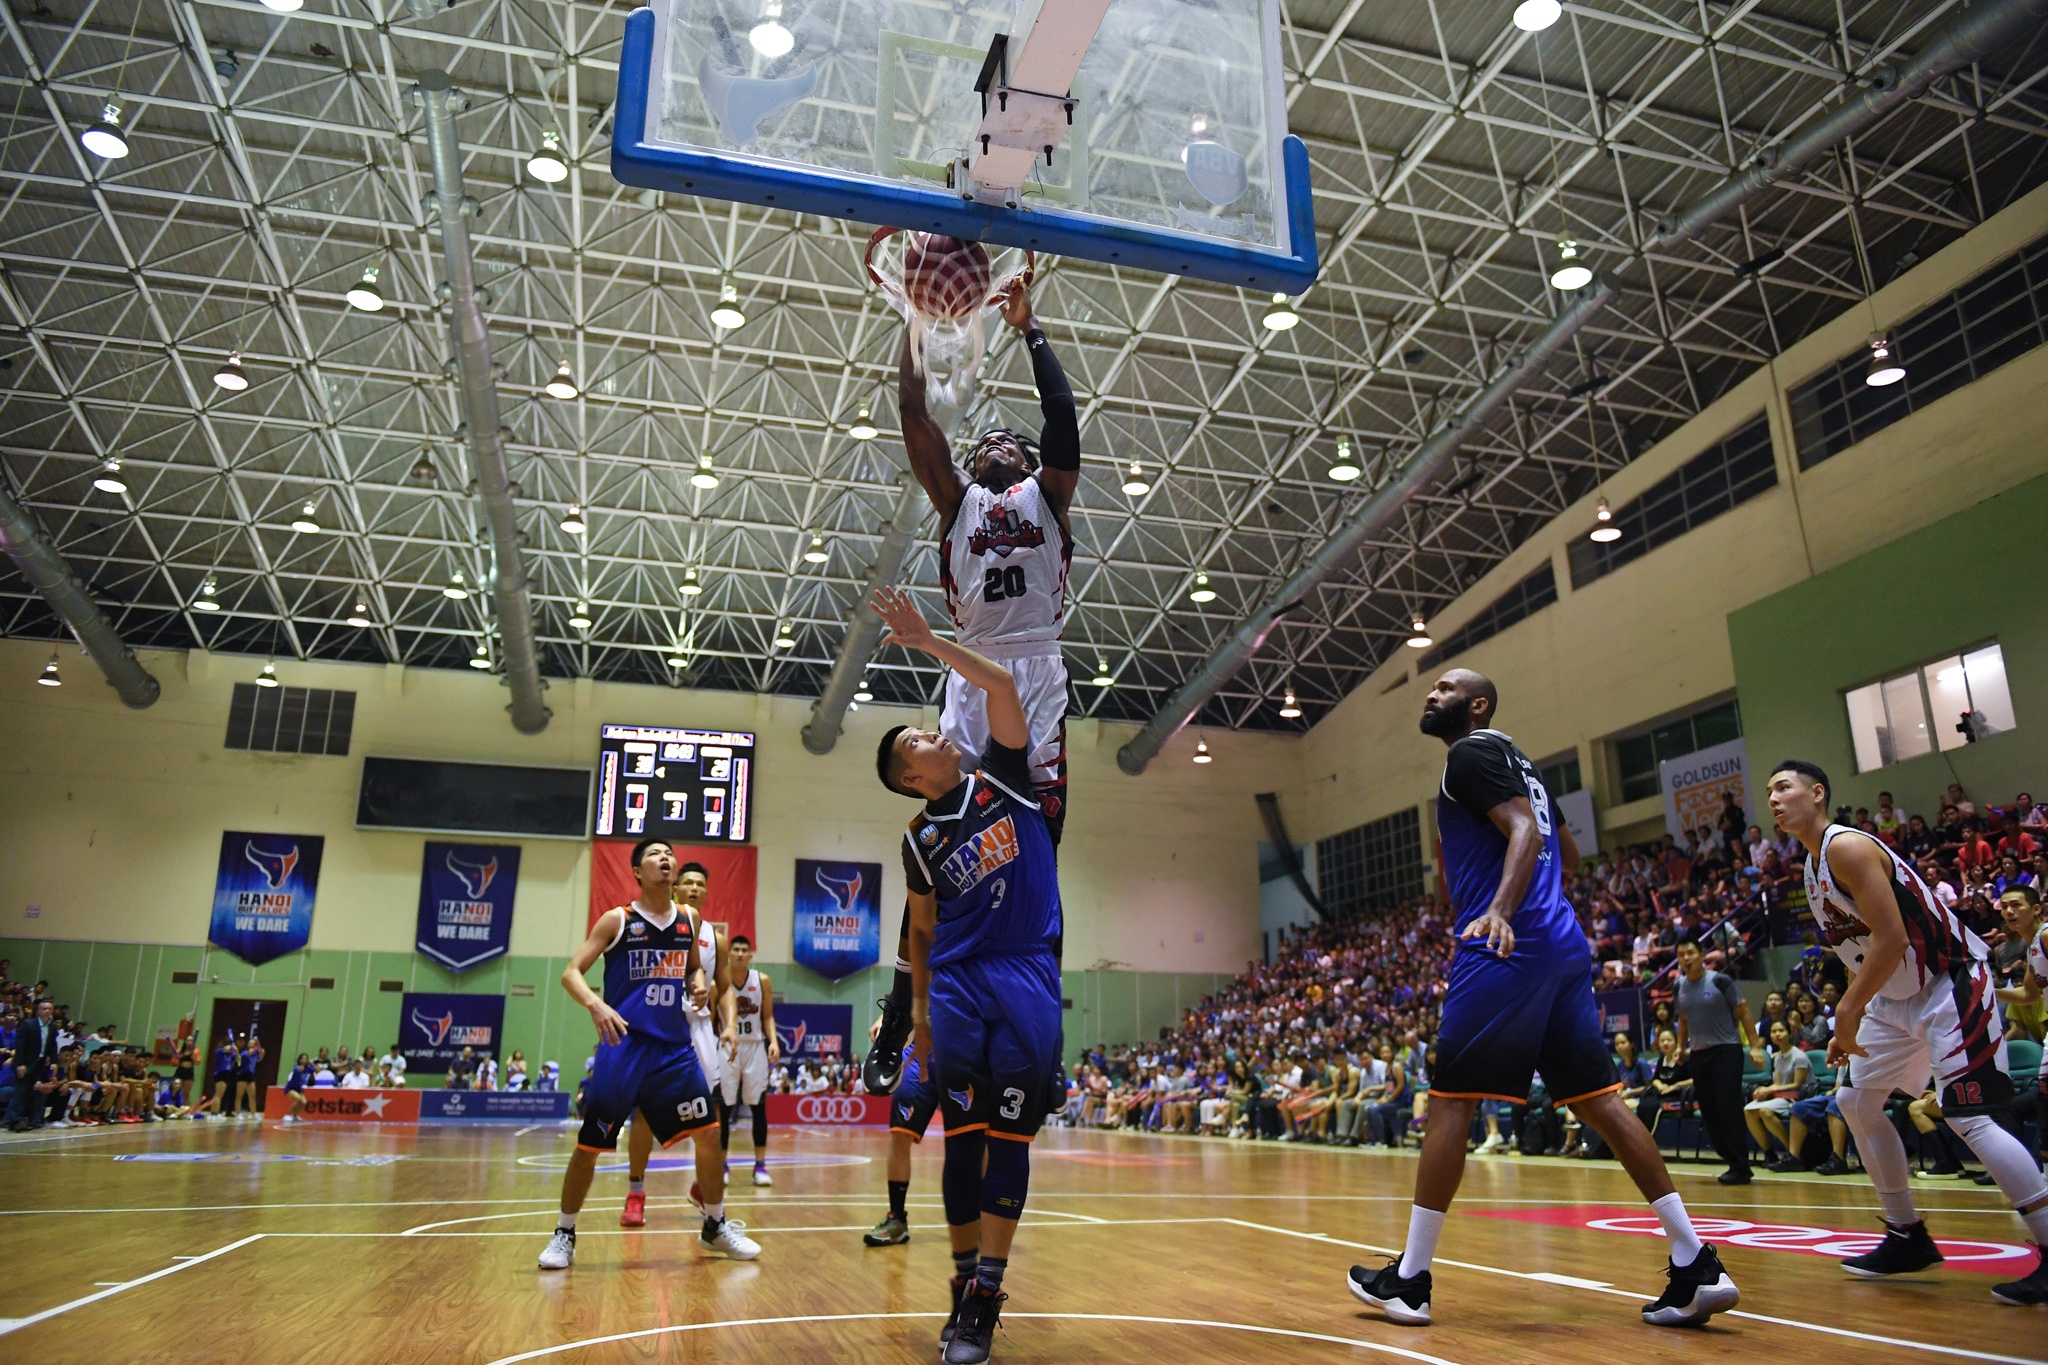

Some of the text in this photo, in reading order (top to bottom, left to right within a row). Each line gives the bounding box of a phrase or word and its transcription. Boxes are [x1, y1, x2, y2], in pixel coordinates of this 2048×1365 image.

[983, 565, 1027, 602] 20
[1672, 757, 1741, 789] GOLDSUN
[921, 826, 935, 839] VBA
[239, 893, 292, 907] HANOI
[990, 877, 1006, 909] 3
[441, 901, 491, 915] HANOI
[235, 917, 289, 932] WE DARE
[814, 915, 860, 928] HANOI
[437, 925, 490, 941] WE DARE
[813, 938, 860, 952] WE DARE
[630, 967, 686, 979] BUFFALOE
[645, 984, 676, 1007] 90
[736, 1021, 752, 1035] 18
[1952, 1081, 1983, 1105] 12
[304, 1098, 364, 1115] etstar
[676, 1096, 709, 1122] 90
[999, 1086, 1026, 1120] 3
